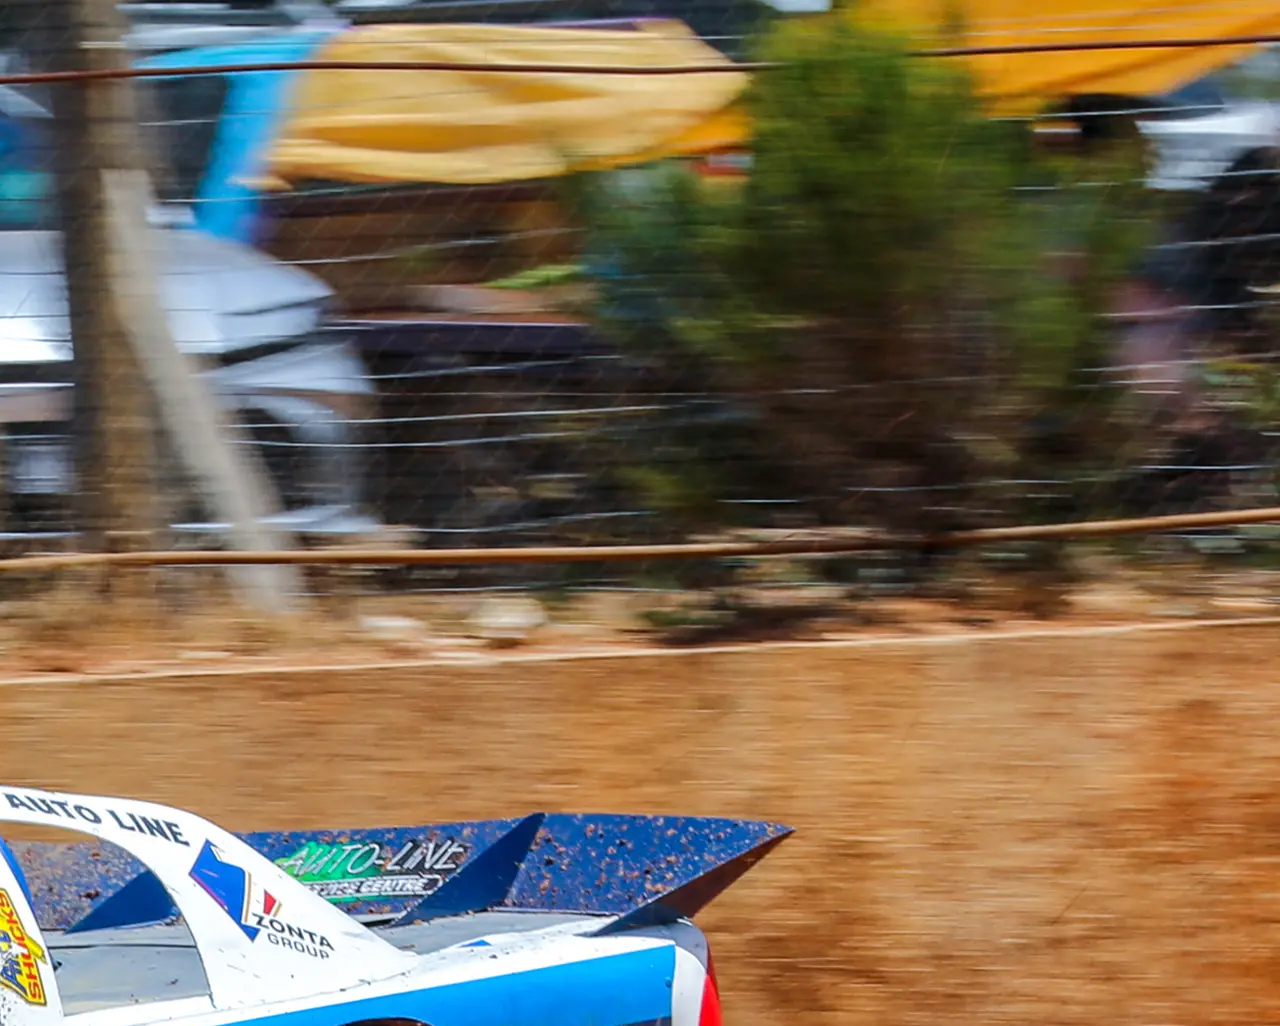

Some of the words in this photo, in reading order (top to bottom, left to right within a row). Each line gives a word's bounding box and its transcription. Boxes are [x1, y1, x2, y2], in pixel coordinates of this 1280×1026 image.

[3, 793, 102, 824] AUTO
[107, 809, 190, 847] LINE
[281, 839, 465, 875] AUTO-LINE
[360, 878, 428, 893] CENTRE
[252, 914, 335, 951] ZONTA
[268, 934, 330, 960] GROUP
